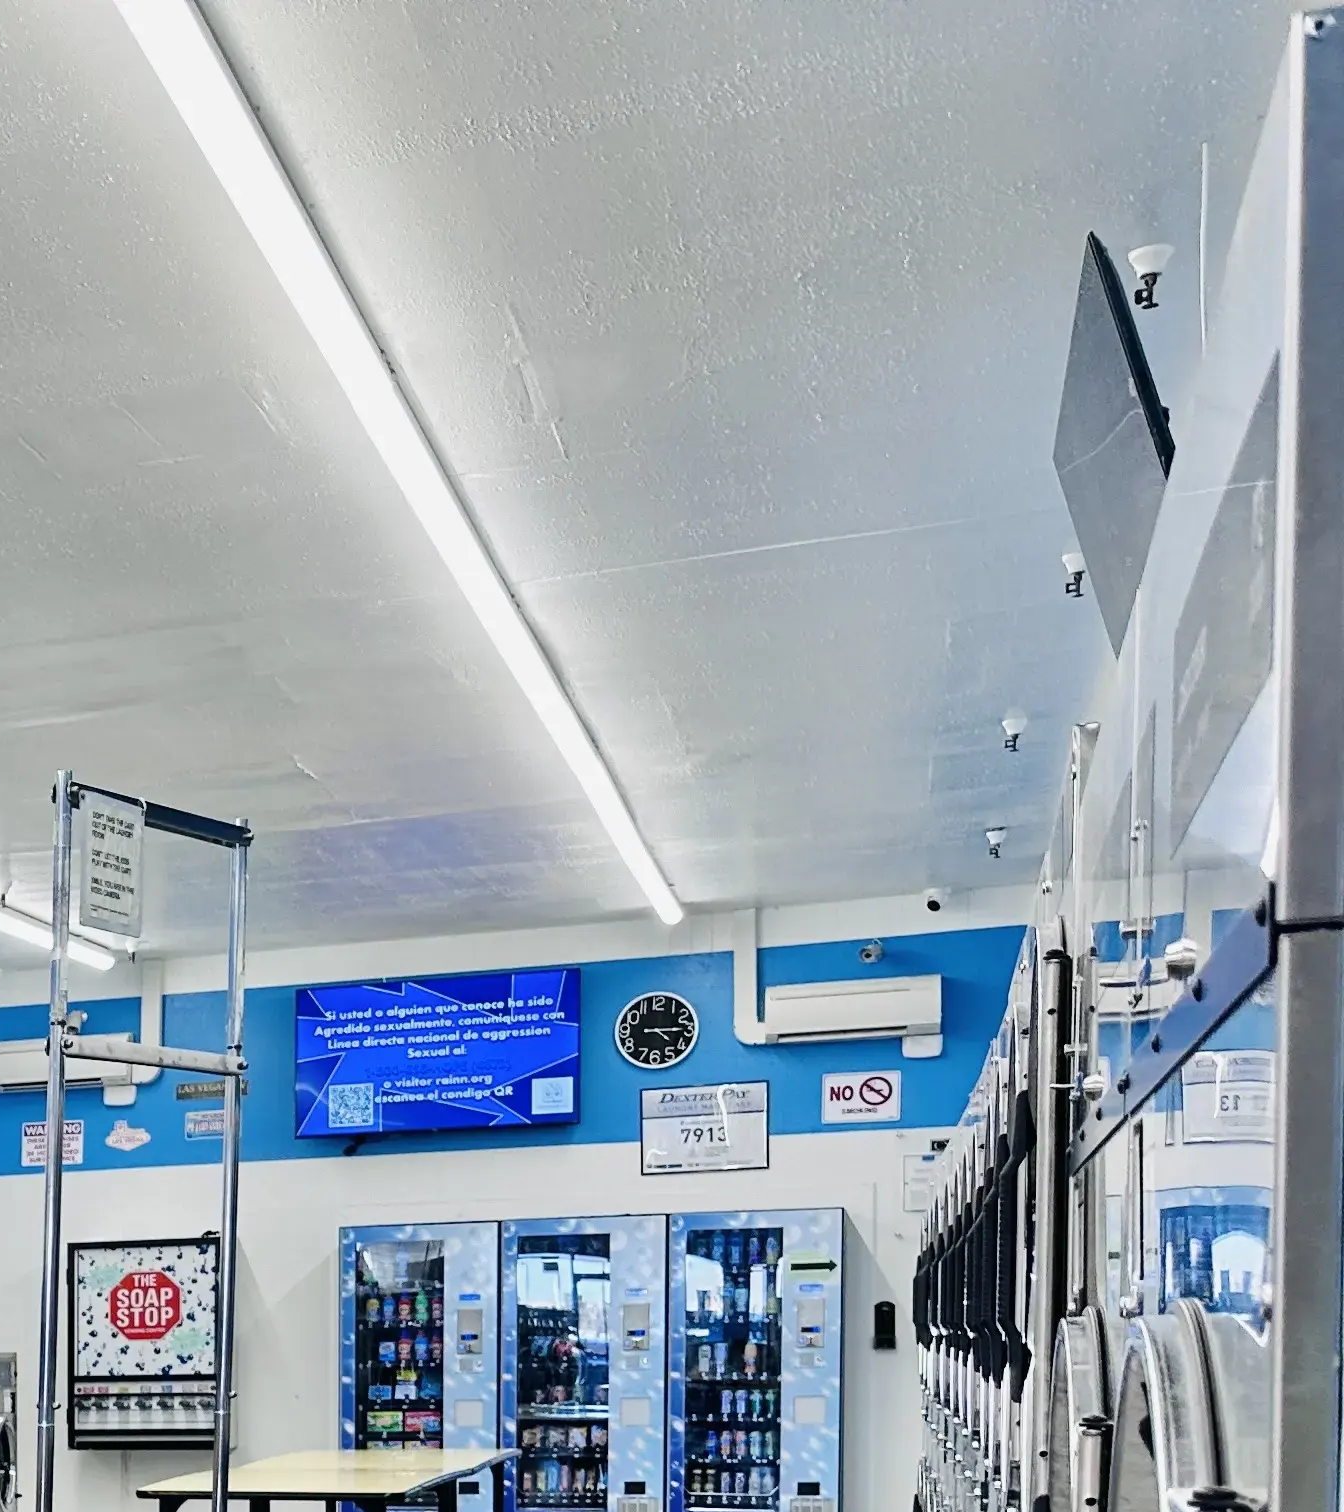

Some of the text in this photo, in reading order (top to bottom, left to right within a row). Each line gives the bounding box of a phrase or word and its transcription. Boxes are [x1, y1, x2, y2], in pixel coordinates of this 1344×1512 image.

[325, 996, 554, 1021] Si usted o alguien que conoce ha sido
[640, 1000, 647, 1014] 11
[652, 996, 665, 1011] 12
[672, 1000, 675, 1014] 1
[627, 1010, 639, 1024] 10
[678, 1008, 689, 1023] 2
[314, 1022, 371, 1038] Agredido
[543, 1010, 565, 1020] con
[619, 1024, 630, 1038] 9
[684, 1022, 693, 1037] 3
[363, 1034, 405, 1048] directa
[408, 1031, 460, 1045] nacional
[463, 1030, 479, 1041] de
[482, 1026, 550, 1042] aggression
[677, 1037, 686, 1050] 4
[408, 1046, 450, 1058] Sexual
[624, 1038, 634, 1052] 8
[639, 1048, 648, 1061] 7
[650, 1050, 660, 1064] 6
[665, 1047, 675, 1061] 5
[384, 1080, 392, 1088] o
[435, 1074, 493, 1089] rainn.org
[427, 1088, 438, 1100] el
[494, 1086, 513, 1097] QR
[830, 1085, 853, 1101] NO
[24, 1122, 81, 1136] WANG
[681, 1126, 726, 1143] 7913
[133, 1274, 157, 1287] THE
[116, 1287, 173, 1308] SOAP
[116, 1307, 174, 1327] STOP
